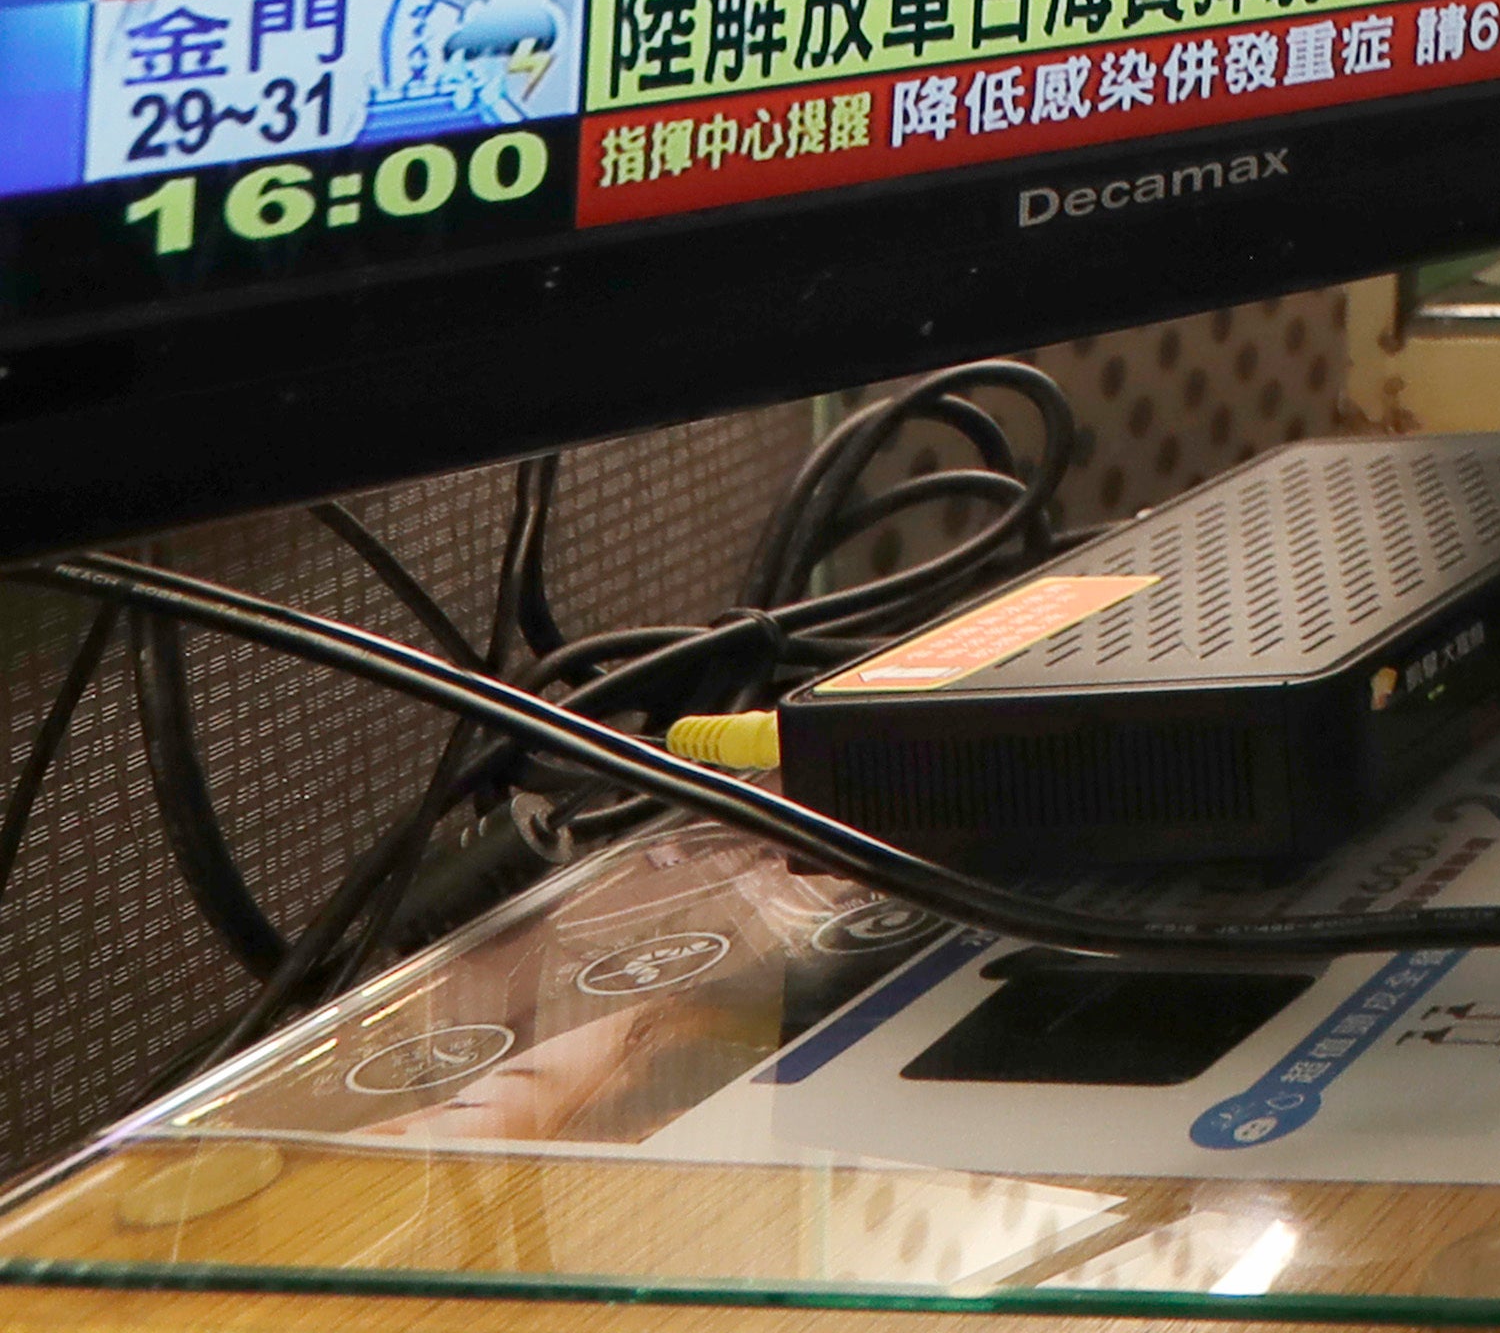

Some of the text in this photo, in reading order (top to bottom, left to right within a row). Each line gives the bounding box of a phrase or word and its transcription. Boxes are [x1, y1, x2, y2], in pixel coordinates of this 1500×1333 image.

[127, 72, 336, 164] 29~31
[599, 91, 872, 188] 指揮中心提醒
[890, 15, 1392, 148] 降低感染併發重症
[122, 130, 551, 257] 16:00
[1018, 143, 1292, 228] Decamax
